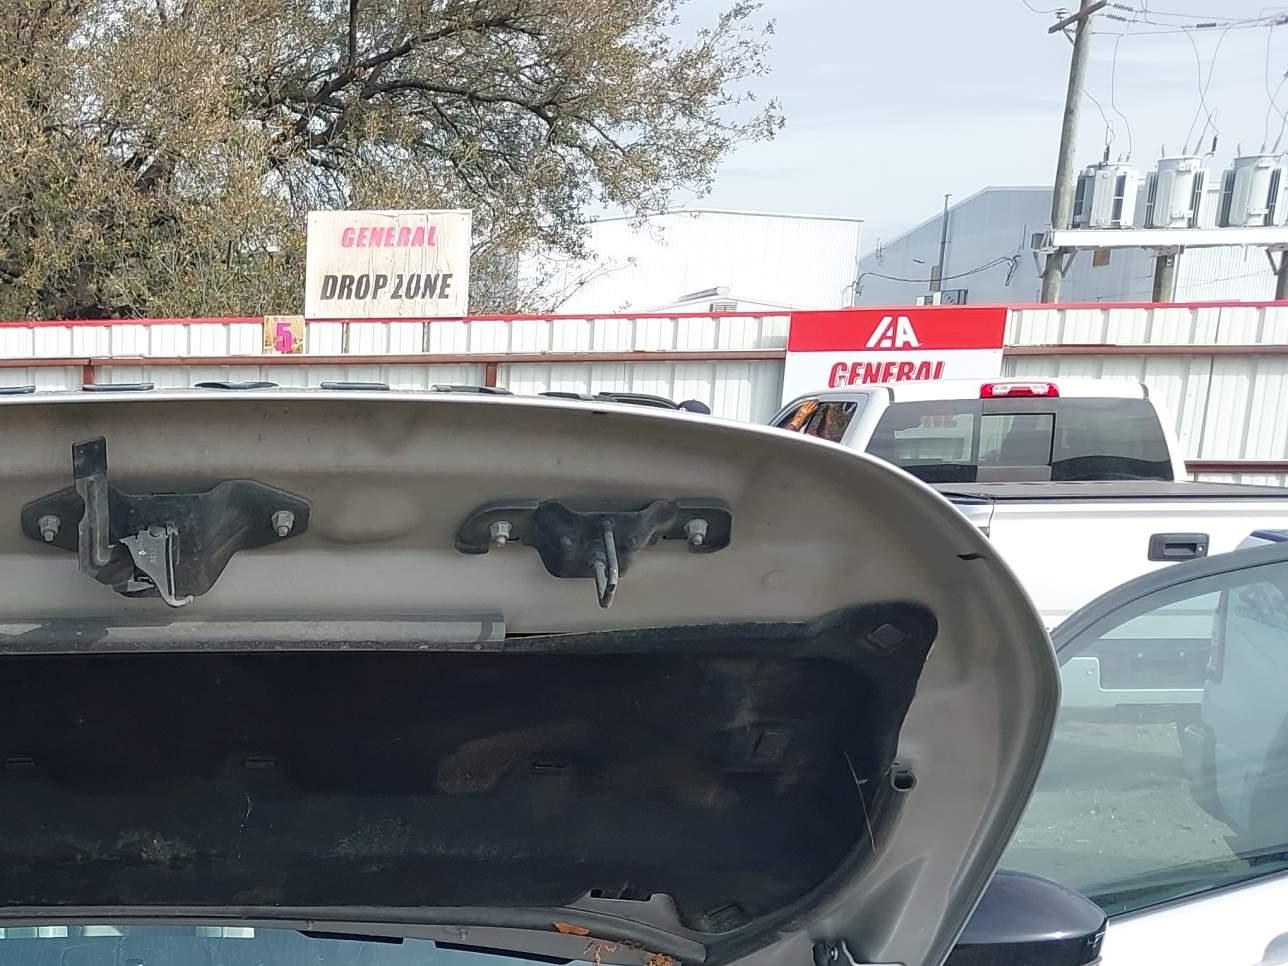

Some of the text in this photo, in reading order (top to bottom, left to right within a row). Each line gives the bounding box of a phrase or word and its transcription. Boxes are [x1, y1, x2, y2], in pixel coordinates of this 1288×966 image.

[341, 226, 437, 248] GENERAL
[320, 273, 453, 300] DROP ZONE
[275, 322, 293, 352] 5
